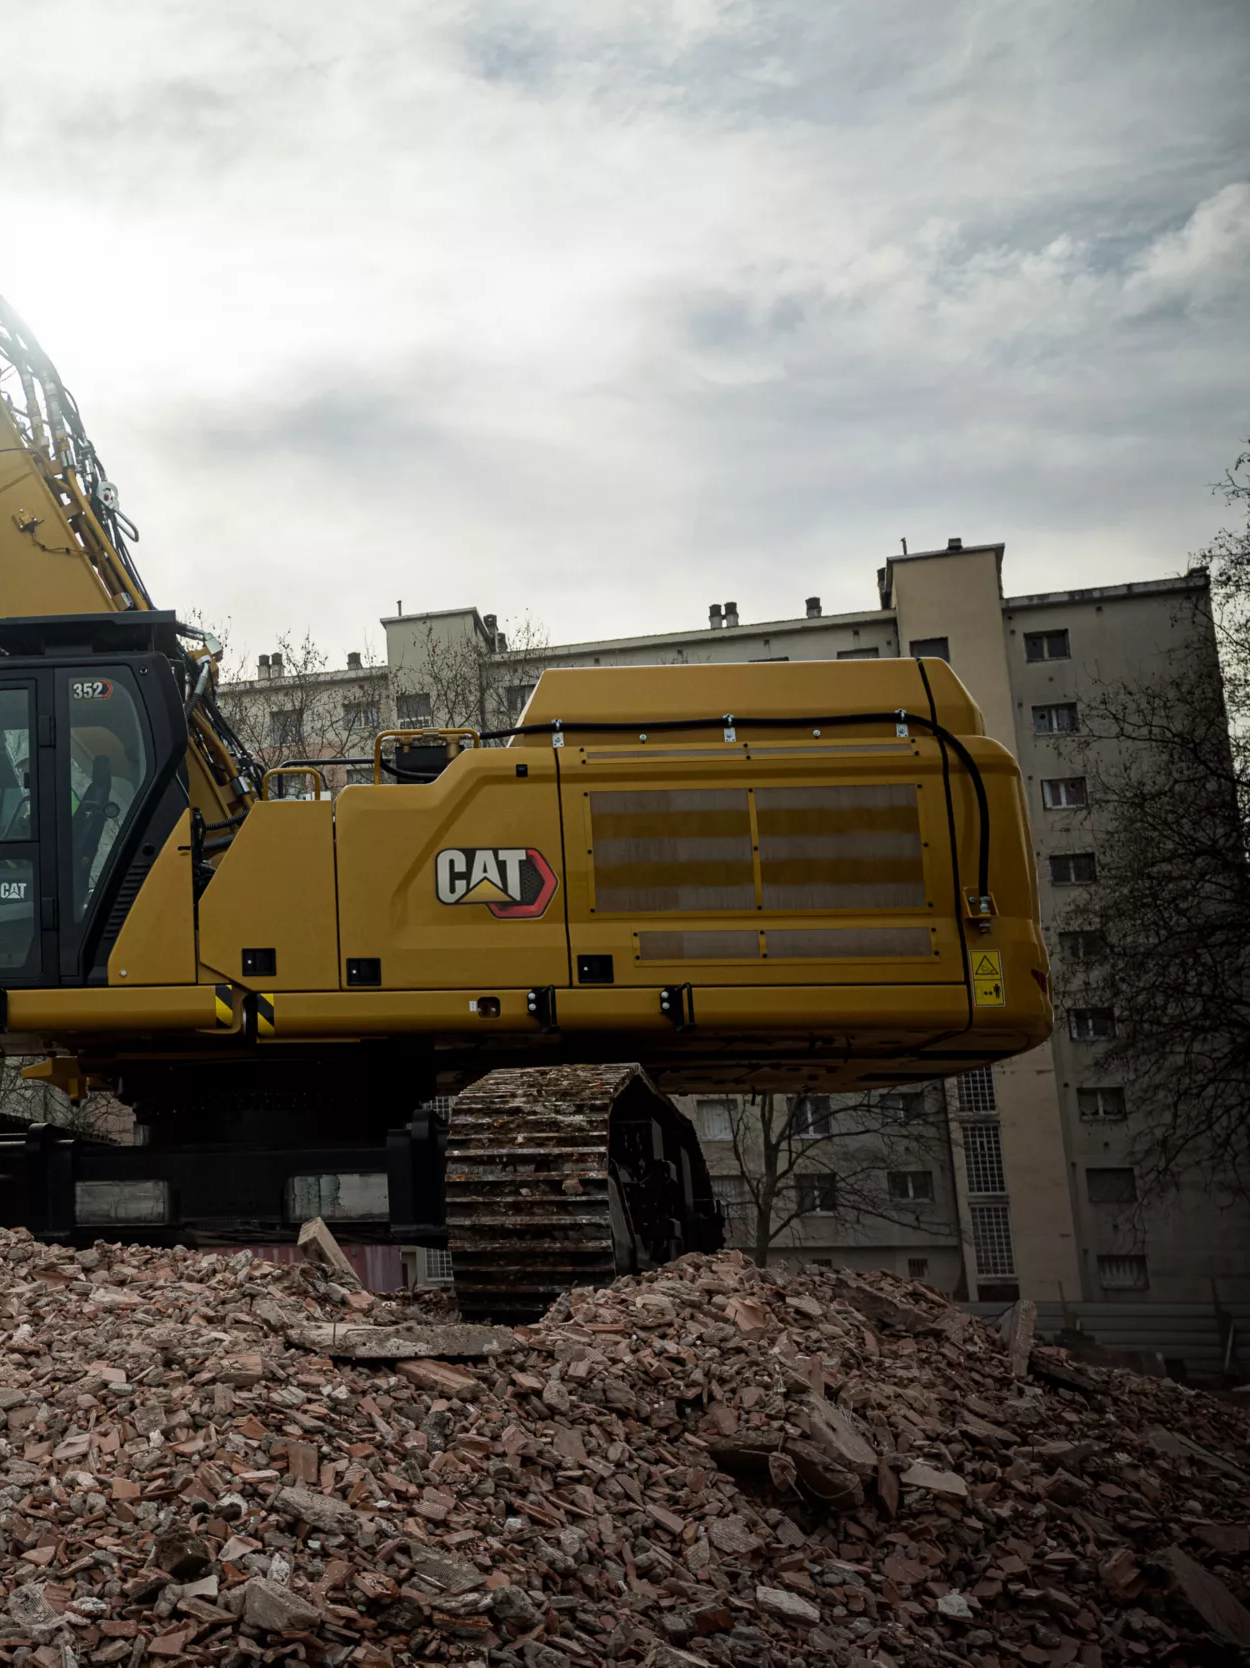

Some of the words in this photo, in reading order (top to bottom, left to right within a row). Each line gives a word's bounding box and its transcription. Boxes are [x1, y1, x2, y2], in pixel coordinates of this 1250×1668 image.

[73, 682, 103, 699] 352
[437, 849, 527, 903] CAT
[0, 882, 27, 898] CAT
